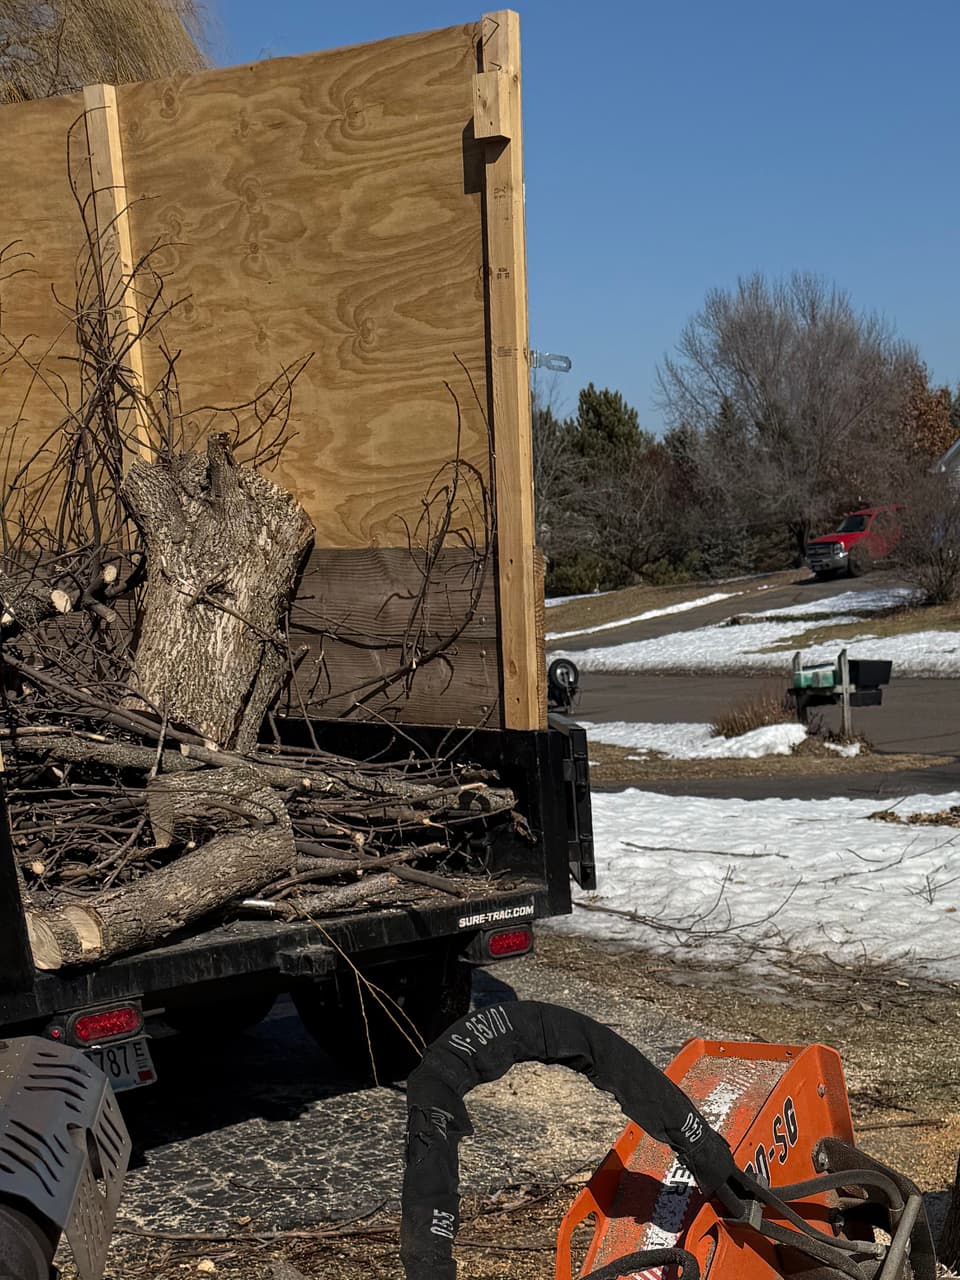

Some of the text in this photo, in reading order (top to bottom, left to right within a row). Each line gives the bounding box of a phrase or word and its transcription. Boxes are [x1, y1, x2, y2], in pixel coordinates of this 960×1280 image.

[458, 905, 534, 928] SURE-TRAC.COM
[133, 1042, 145, 1057] E
[680, 1112, 703, 1142] 055
